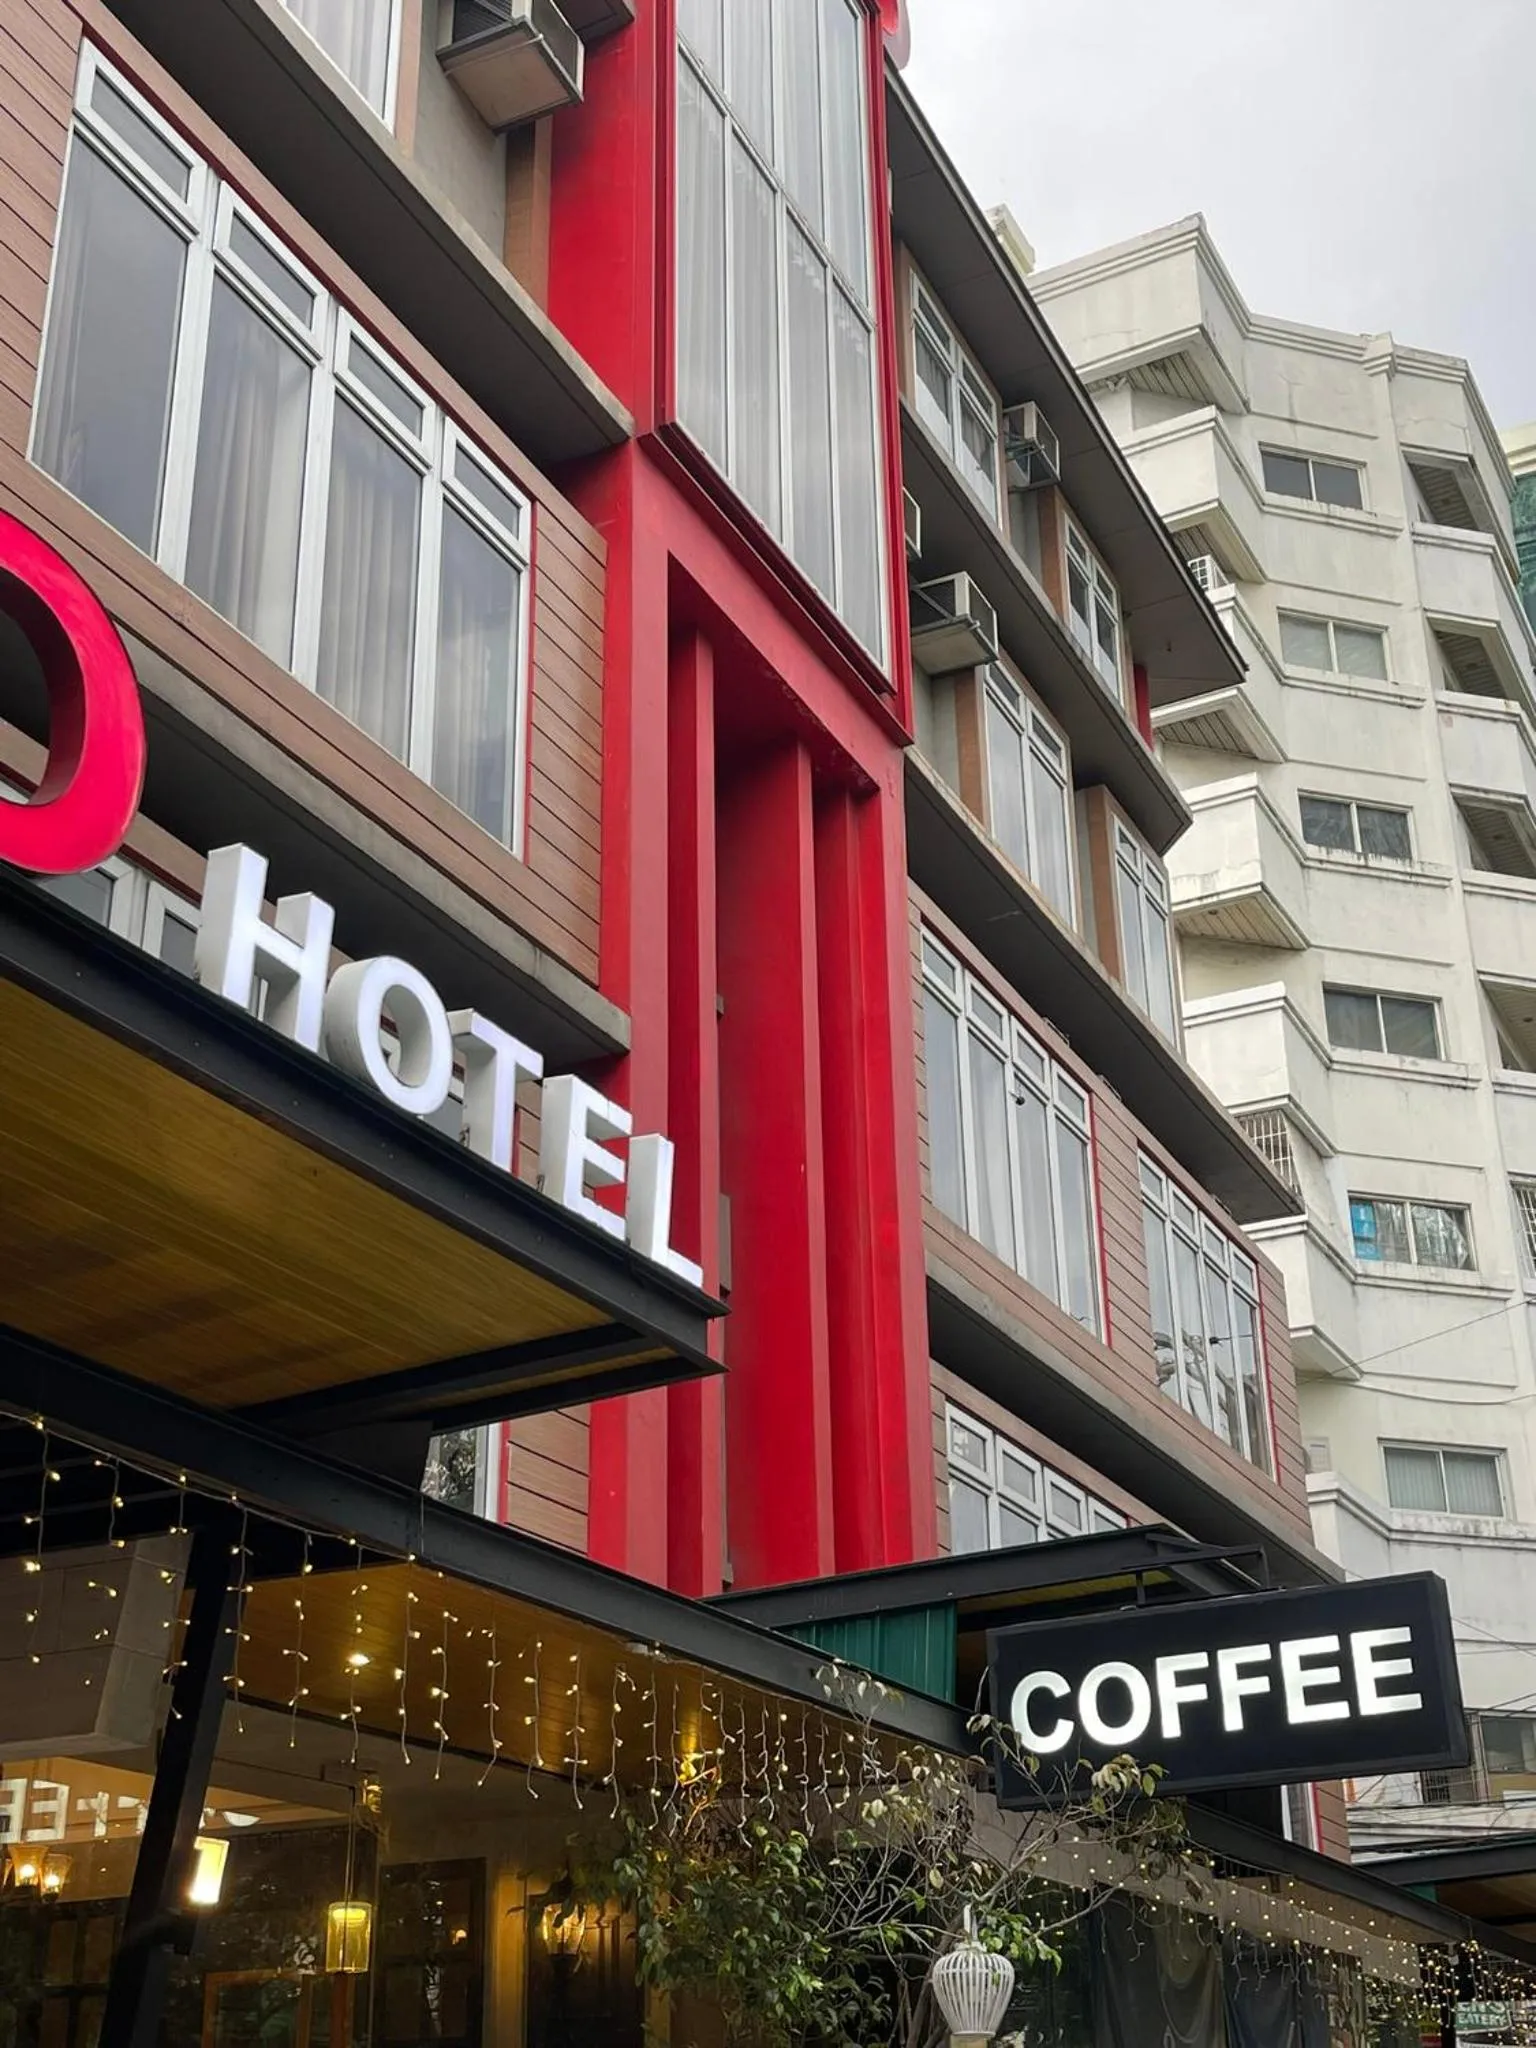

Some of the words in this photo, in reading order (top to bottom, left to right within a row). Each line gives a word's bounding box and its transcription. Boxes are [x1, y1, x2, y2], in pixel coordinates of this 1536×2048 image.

[195, 842, 703, 1286] HOTEL
[1011, 1626, 1422, 1754] COFFEE
[1457, 2012, 1507, 2026] EATERY
